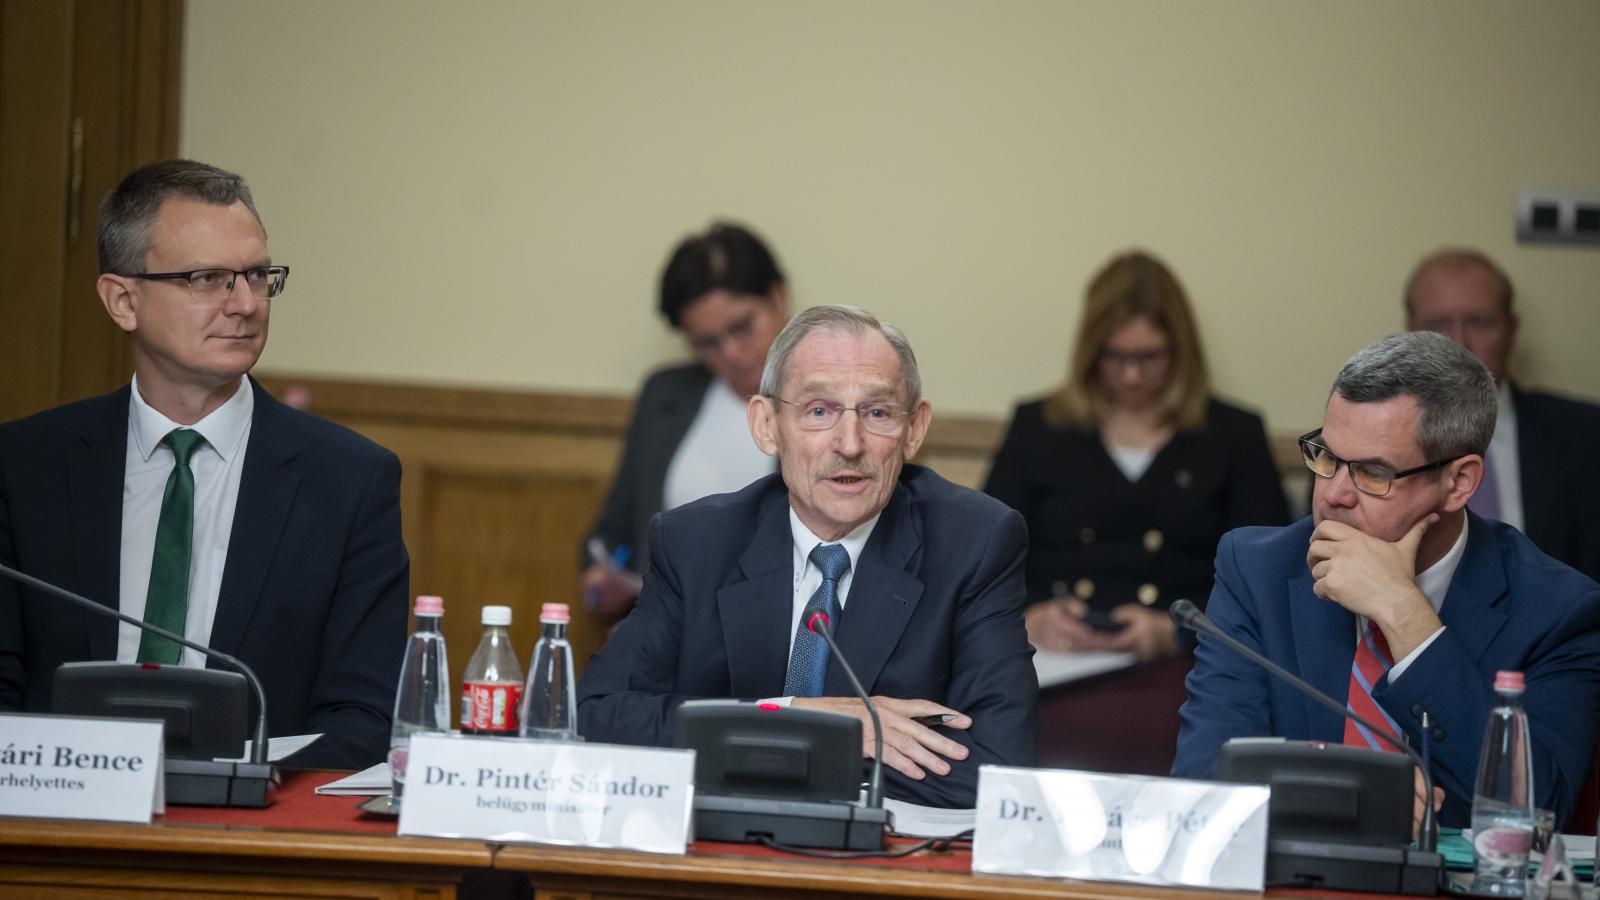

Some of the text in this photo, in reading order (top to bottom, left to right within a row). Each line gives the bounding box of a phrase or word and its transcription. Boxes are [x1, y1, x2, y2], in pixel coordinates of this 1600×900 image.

[0, 742, 143, 771] ári Bence
[424, 766, 670, 798] Dr. Pintér Sándor
[999, 798, 1044, 822] Dr.
